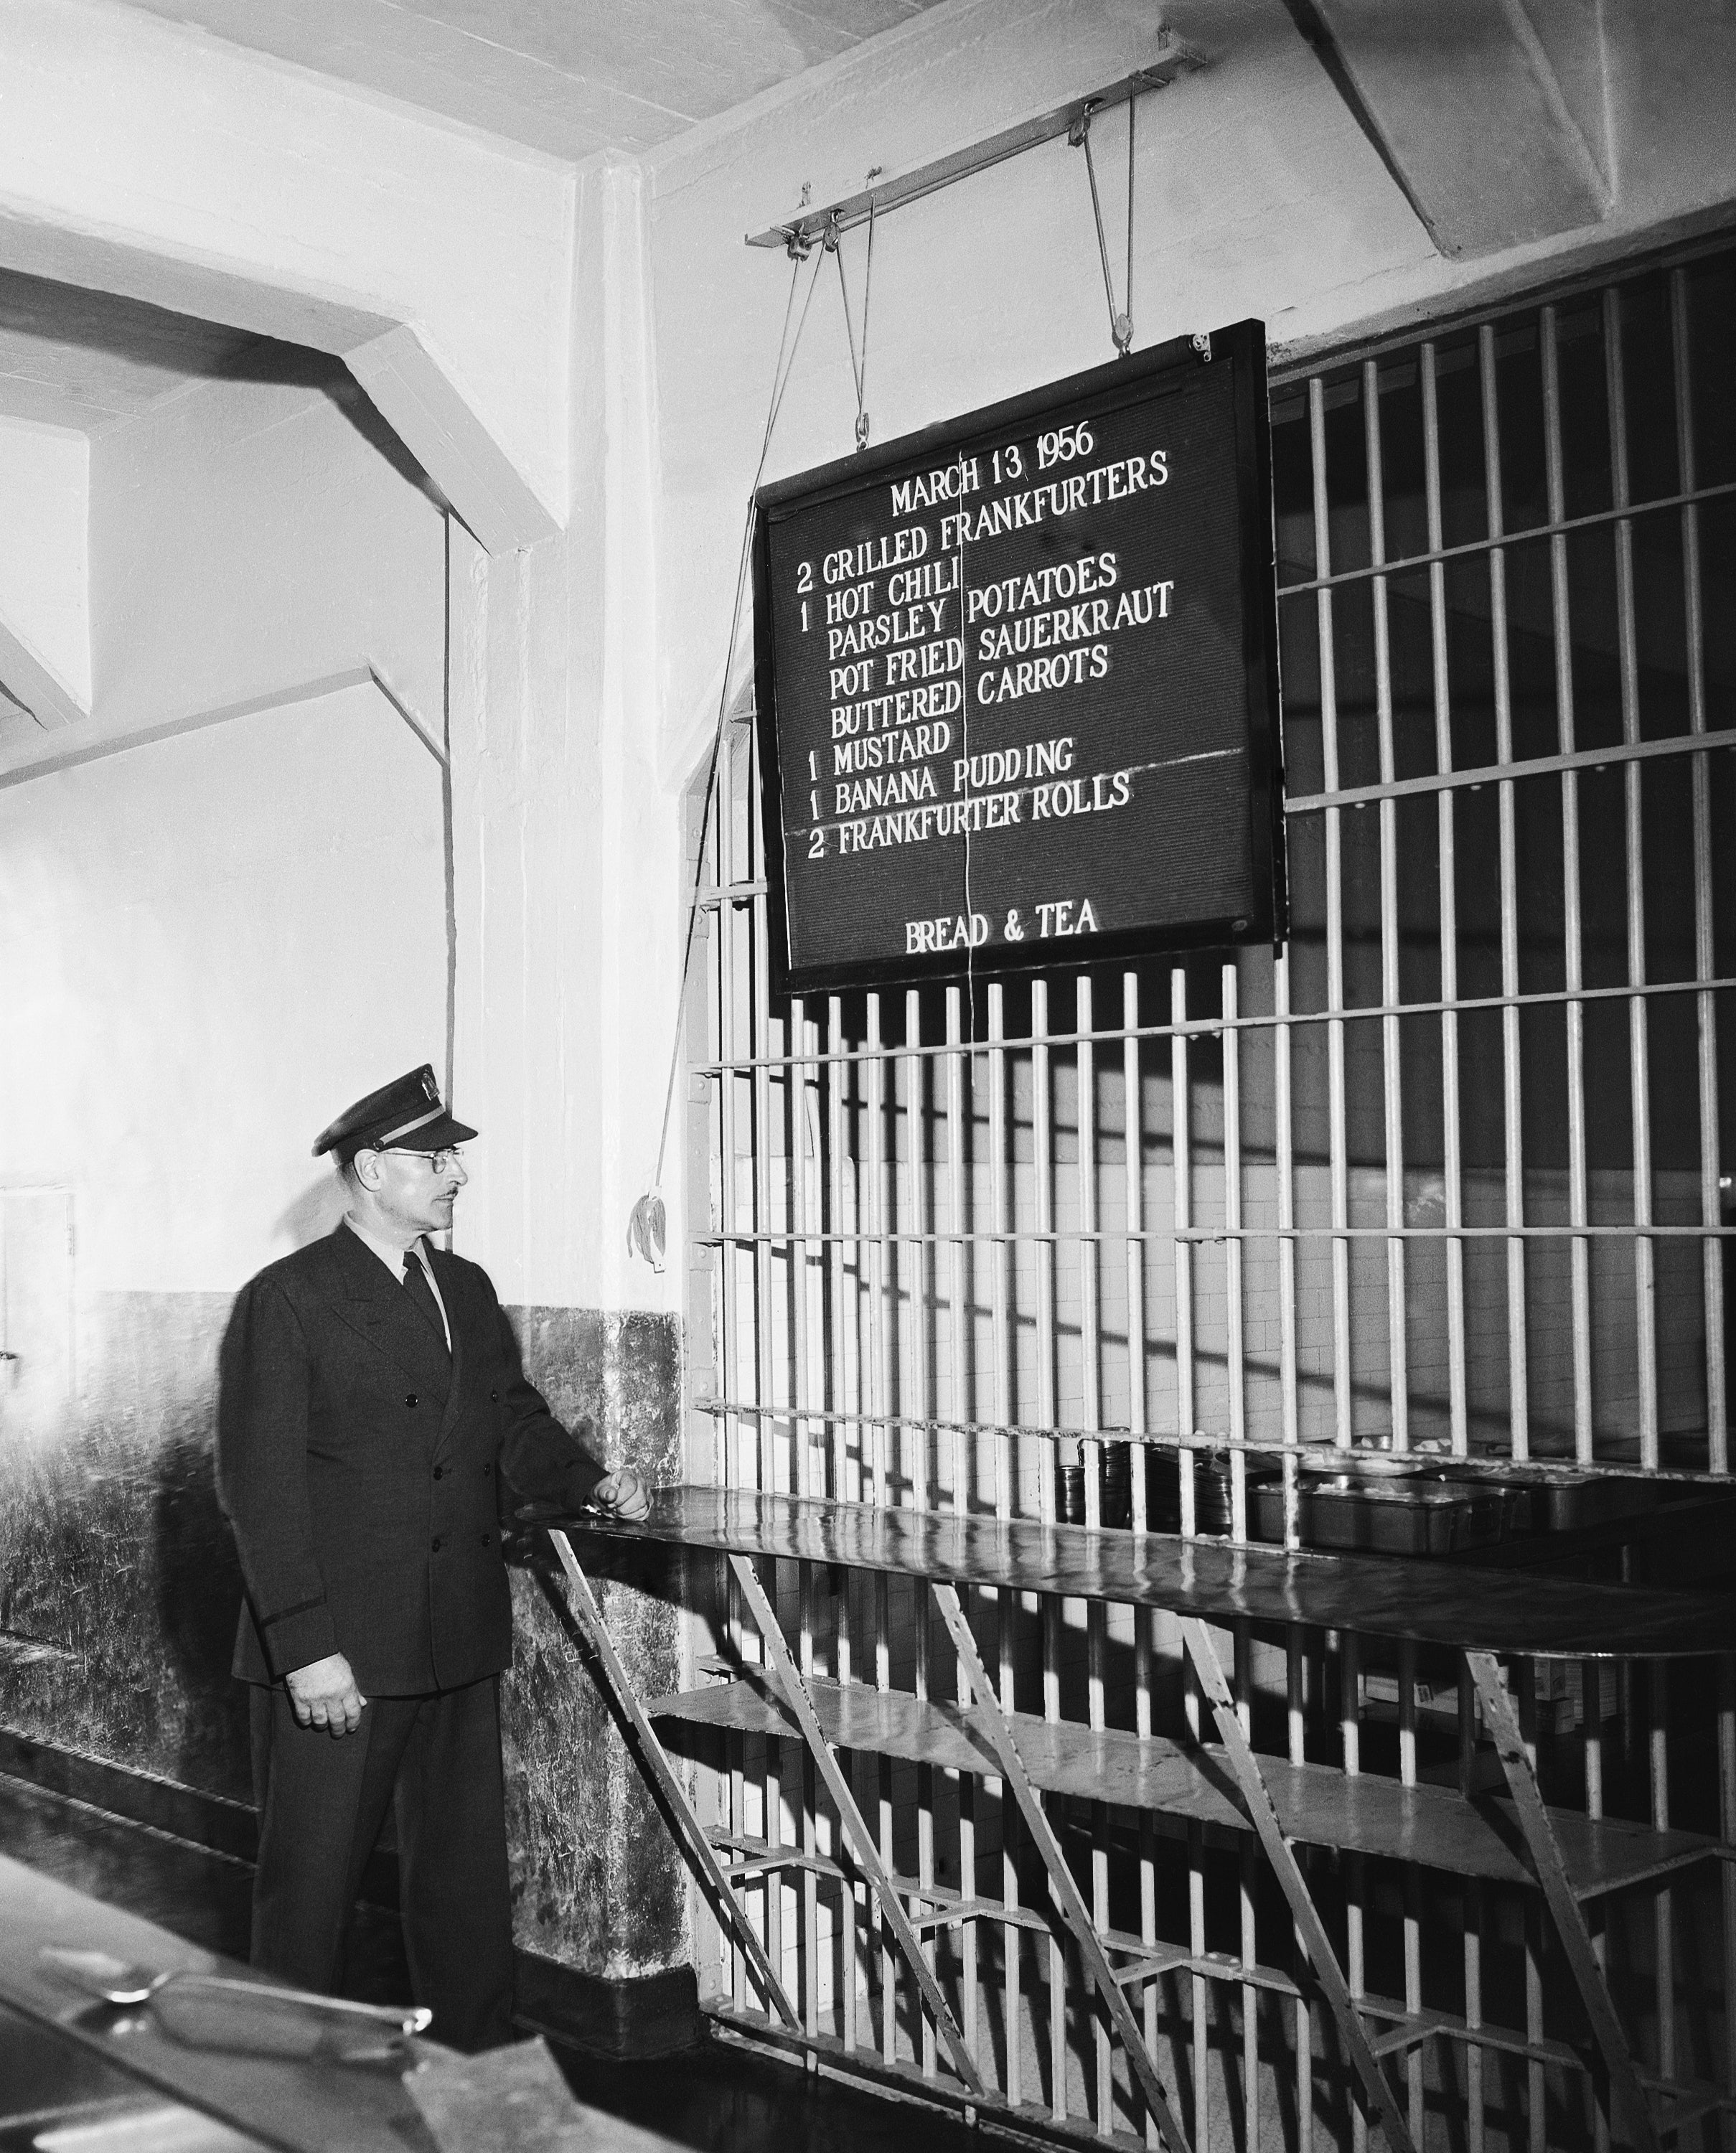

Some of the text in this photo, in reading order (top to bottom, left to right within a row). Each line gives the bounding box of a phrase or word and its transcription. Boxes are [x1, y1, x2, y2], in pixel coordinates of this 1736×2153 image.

[891, 421, 1094, 517] MARCH 13 1956
[797, 450, 1169, 594] 2 GRILLED FRANKFURTERS
[801, 556, 960, 632] 1 HOT CHILI
[827, 552, 1118, 660] PARSLEY POTATOES
[830, 580, 1175, 700] POT FRIED SAUERKRAUT
[830, 644, 1109, 739] BUTTERED CARROTS
[808, 721, 950, 782] 1 MUSTARD
[810, 737, 1074, 820] 1 BANANA PUDDING
[807, 771, 1130, 859] 2 FRANKFURTER ROLLS
[905, 899, 1099, 954] BREAD & TEA
